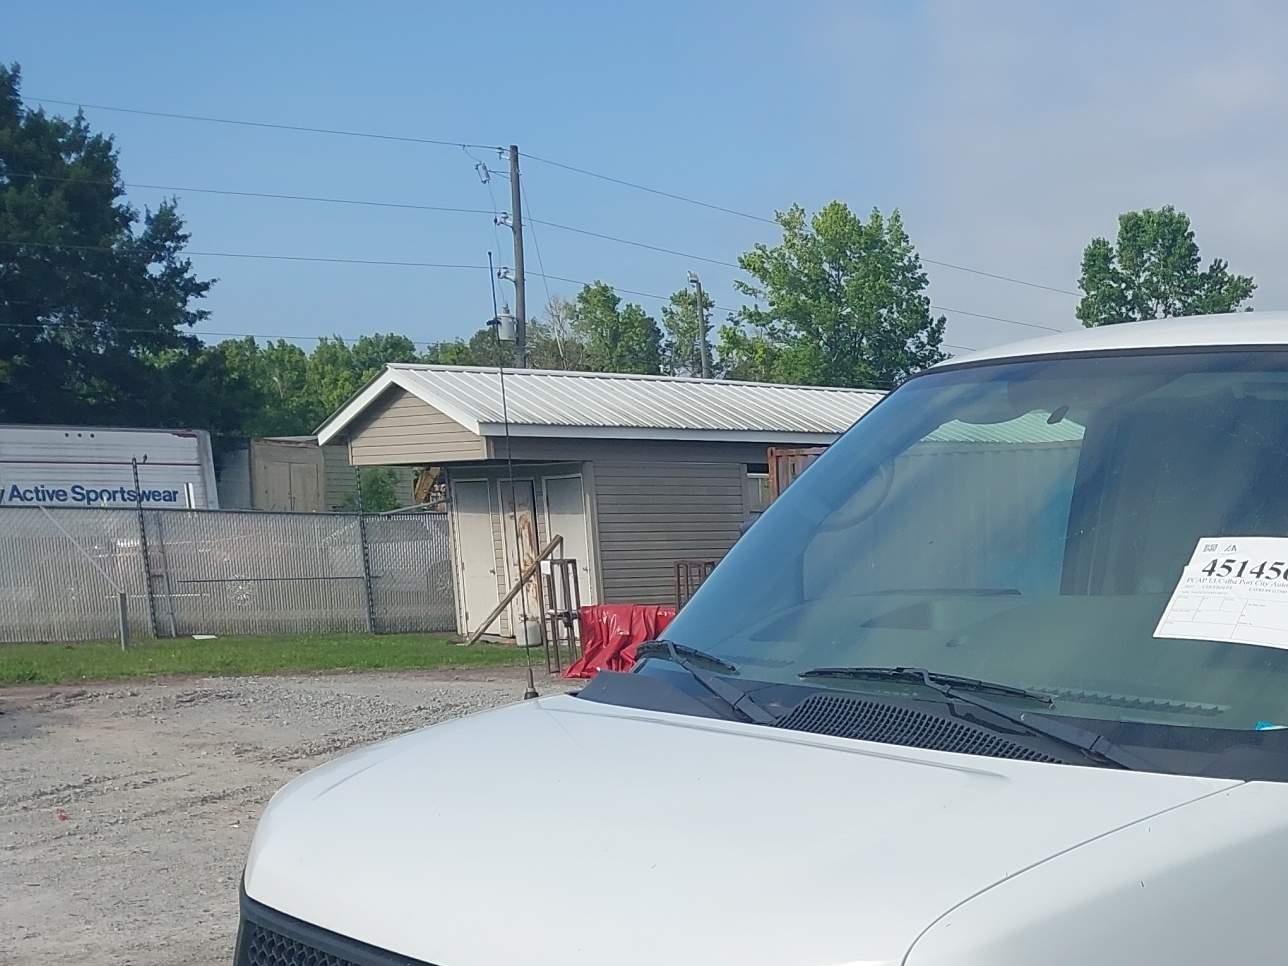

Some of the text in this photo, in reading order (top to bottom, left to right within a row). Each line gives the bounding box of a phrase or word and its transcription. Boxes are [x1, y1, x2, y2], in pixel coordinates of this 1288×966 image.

[9, 484, 67, 502] Active
[71, 485, 179, 505] Sportswear
[1255, 579, 1269, 588] City
